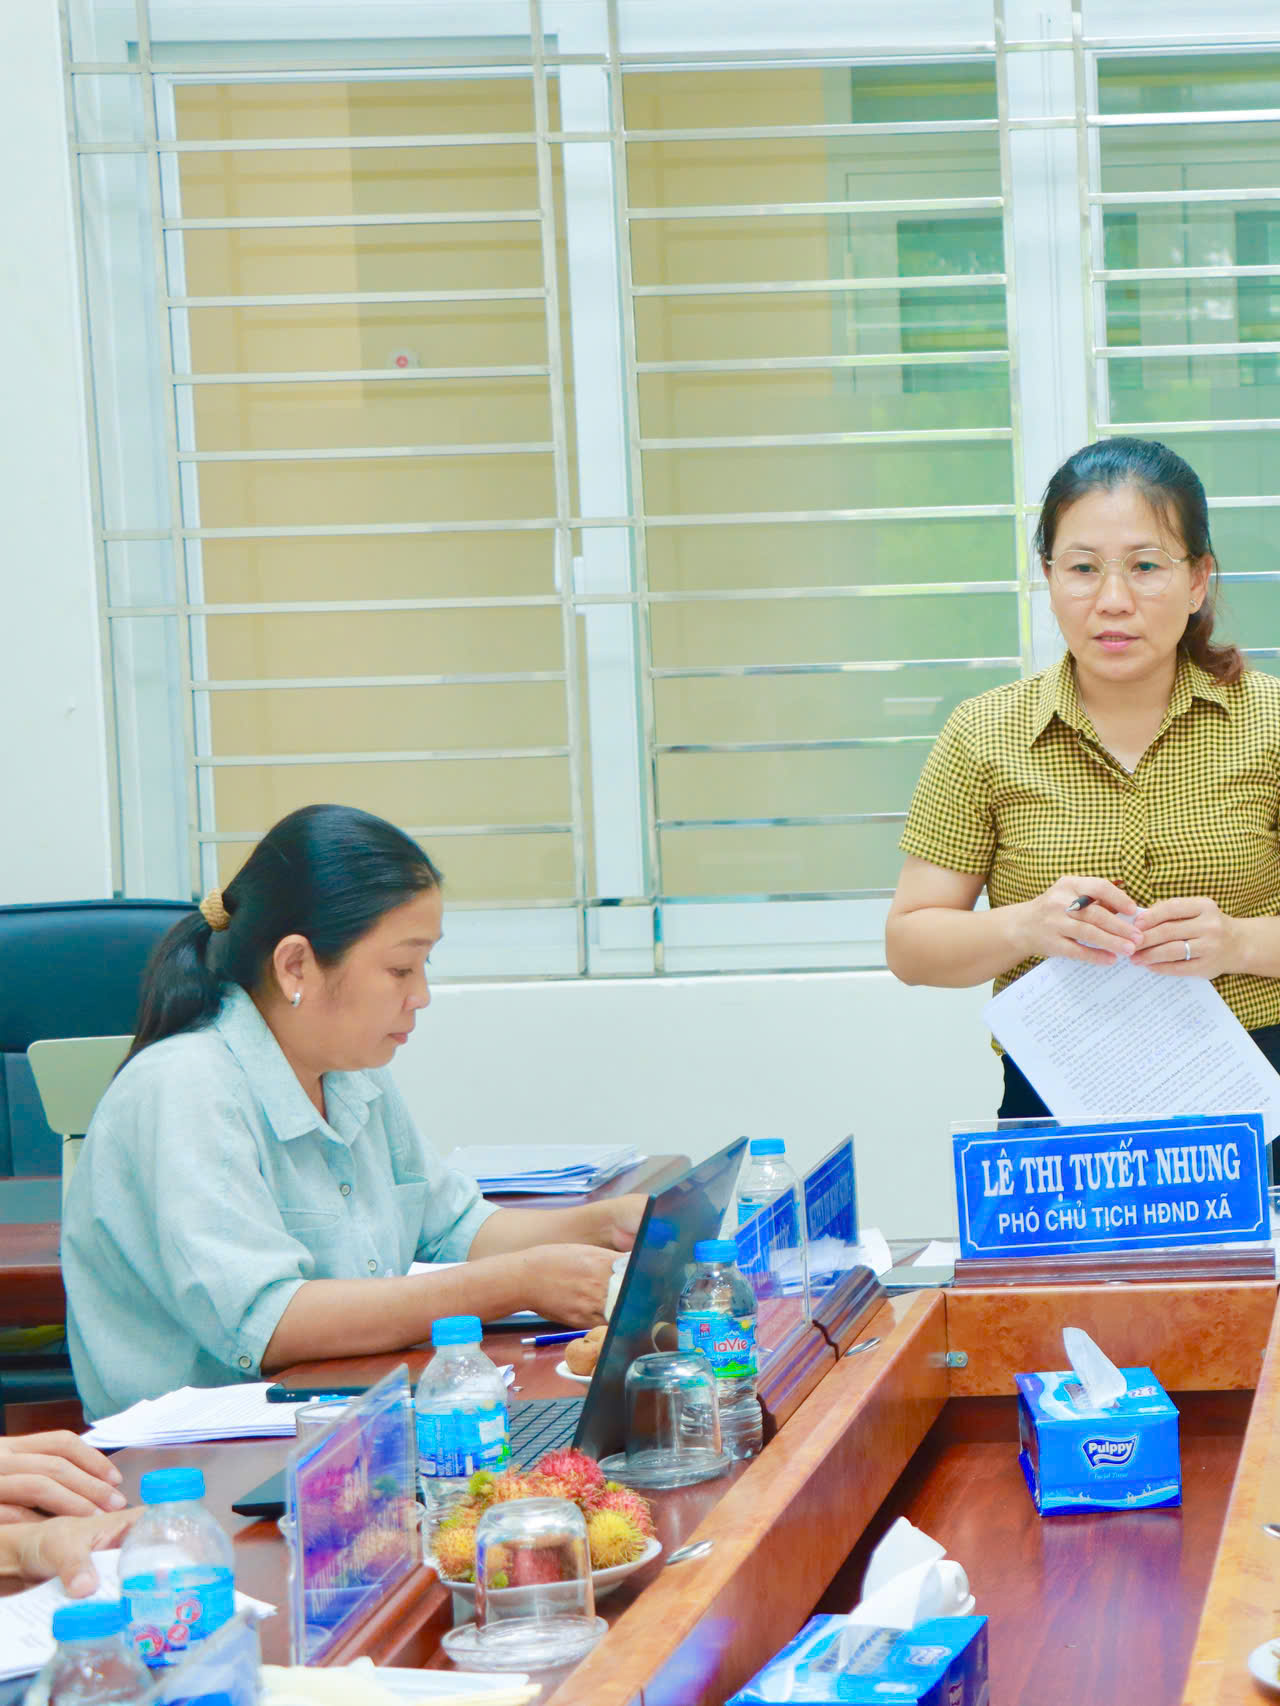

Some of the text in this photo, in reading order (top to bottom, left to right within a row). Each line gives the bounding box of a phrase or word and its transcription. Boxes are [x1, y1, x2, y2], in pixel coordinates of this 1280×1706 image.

[982, 1137, 1240, 1202] LÊ THỊ TUYẾT NHUNG
[998, 1193, 1232, 1234] PHÓ CHỦ TỊCH HĐND XÃ
[1088, 1441, 1132, 1455] Pulppy
